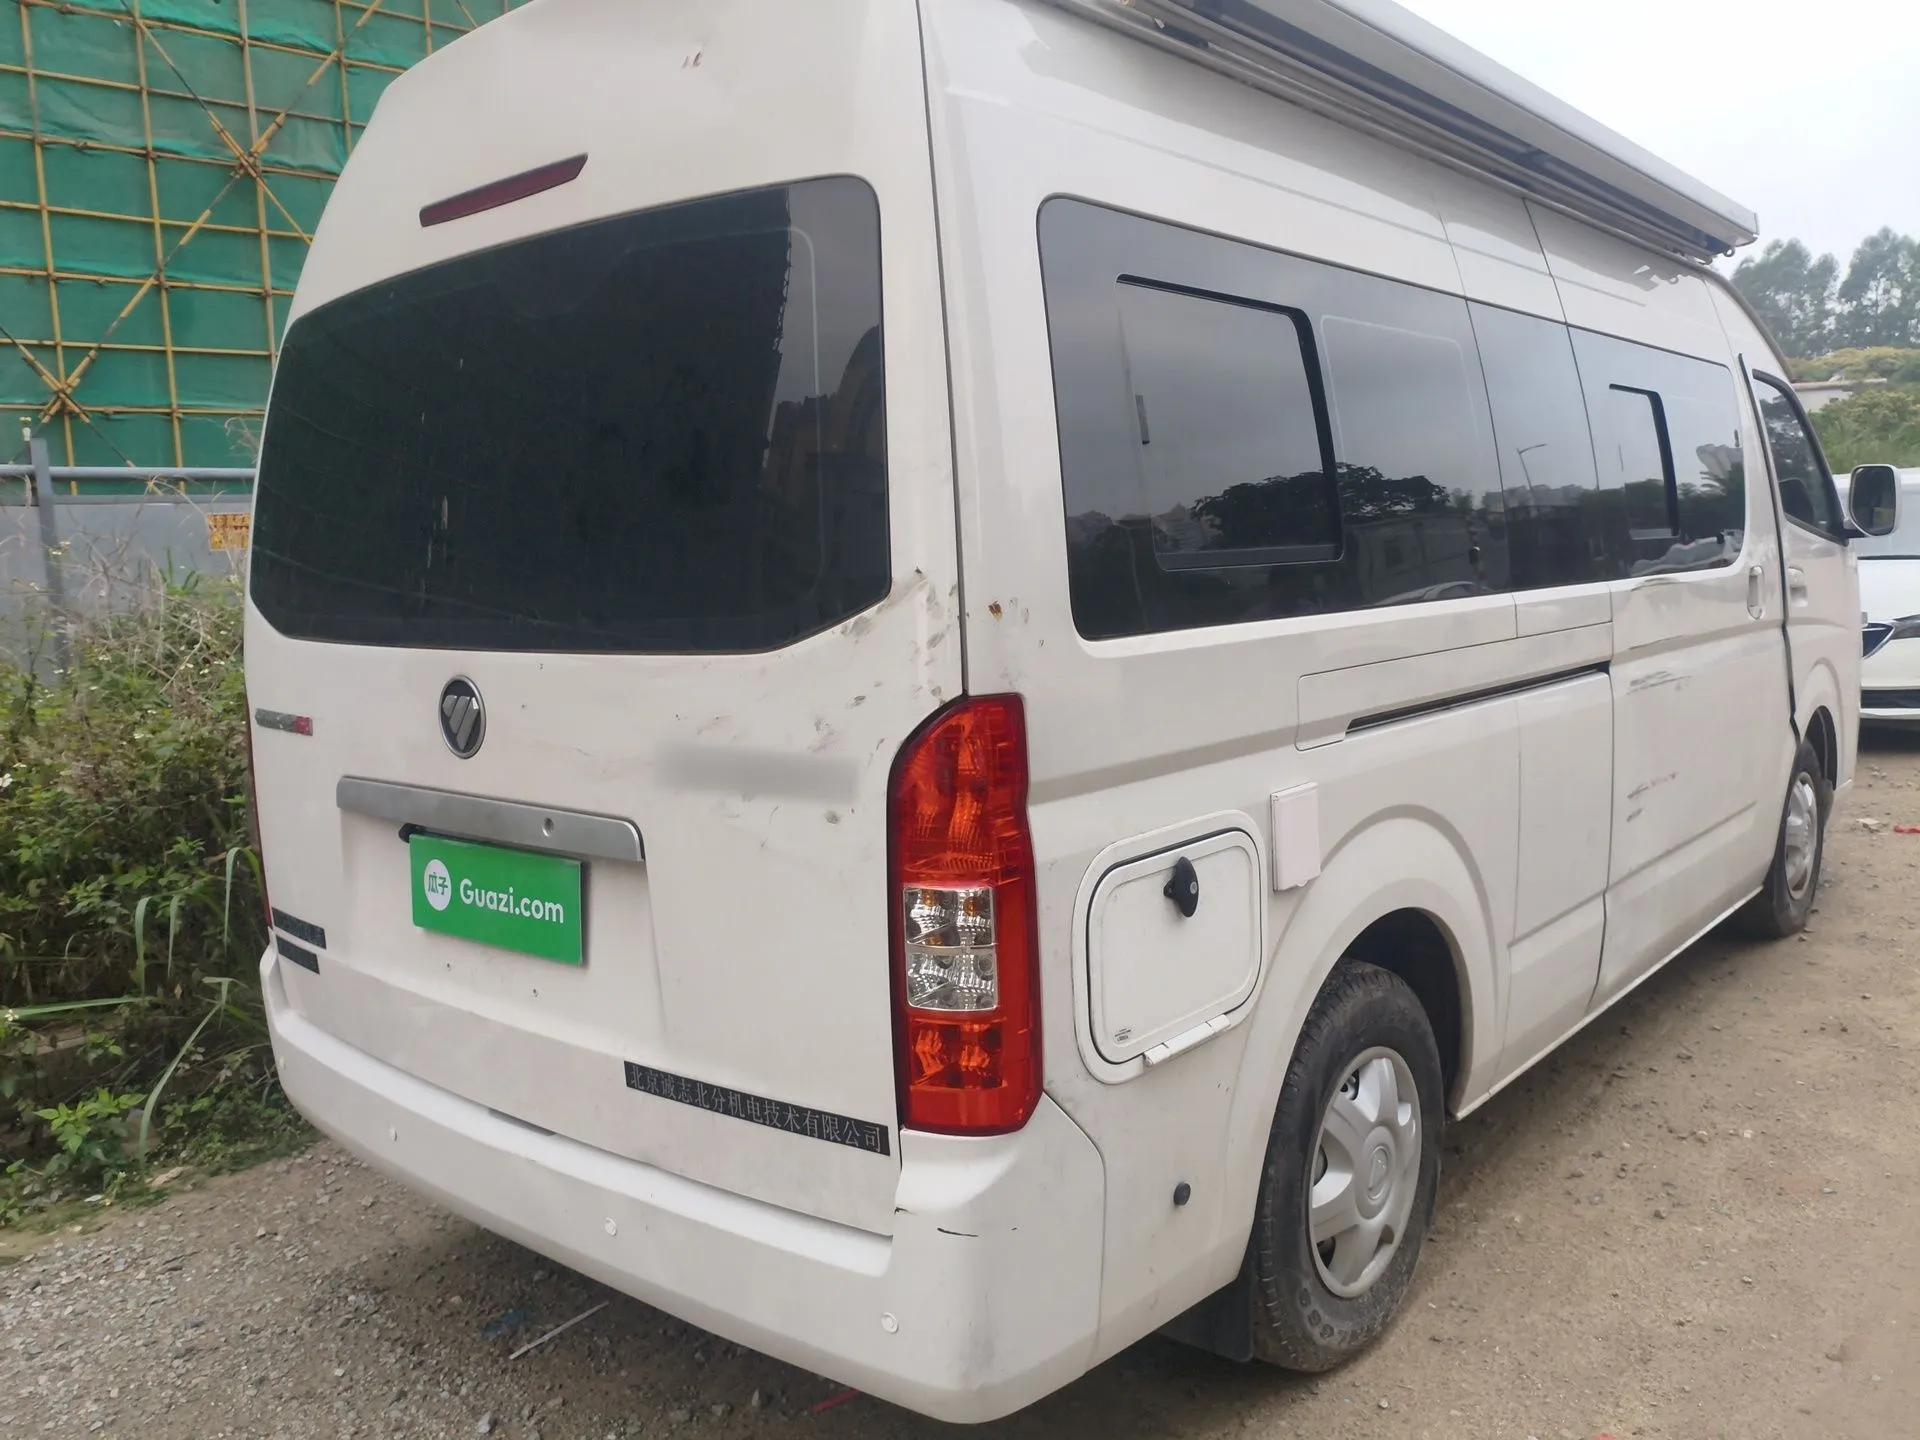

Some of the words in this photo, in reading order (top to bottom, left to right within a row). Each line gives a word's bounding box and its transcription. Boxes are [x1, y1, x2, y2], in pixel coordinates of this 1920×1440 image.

[428, 871, 449, 895] 瓜子
[459, 878, 564, 924] Guazi.com
[630, 1064, 882, 1153] 北京诚志北分机电技术有限公司
